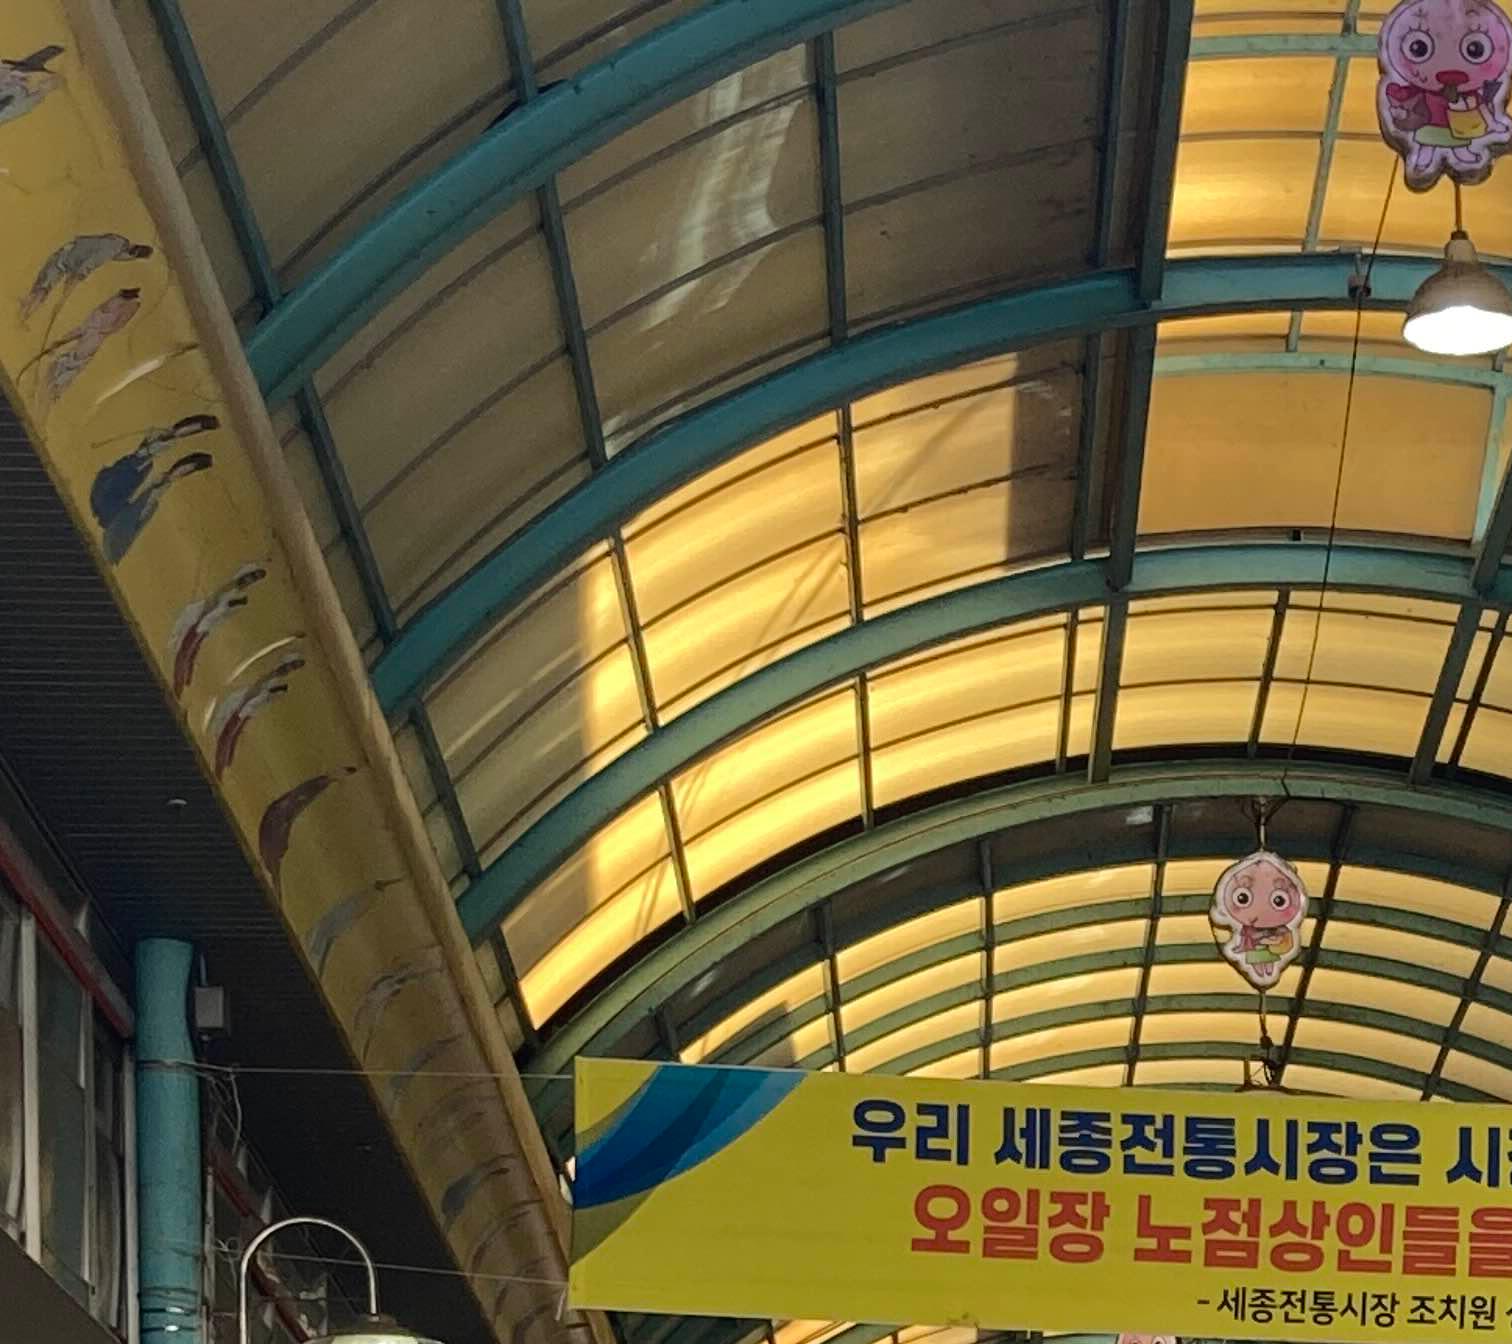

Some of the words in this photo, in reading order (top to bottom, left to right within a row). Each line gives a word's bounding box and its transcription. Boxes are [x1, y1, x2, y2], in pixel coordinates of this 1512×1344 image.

[851, 1098, 971, 1164] 우리
[992, 1105, 1424, 1188] 세종전통시장은
[910, 1184, 1109, 1264] 오일장
[1407, 1295, 1497, 1330] 조치원
